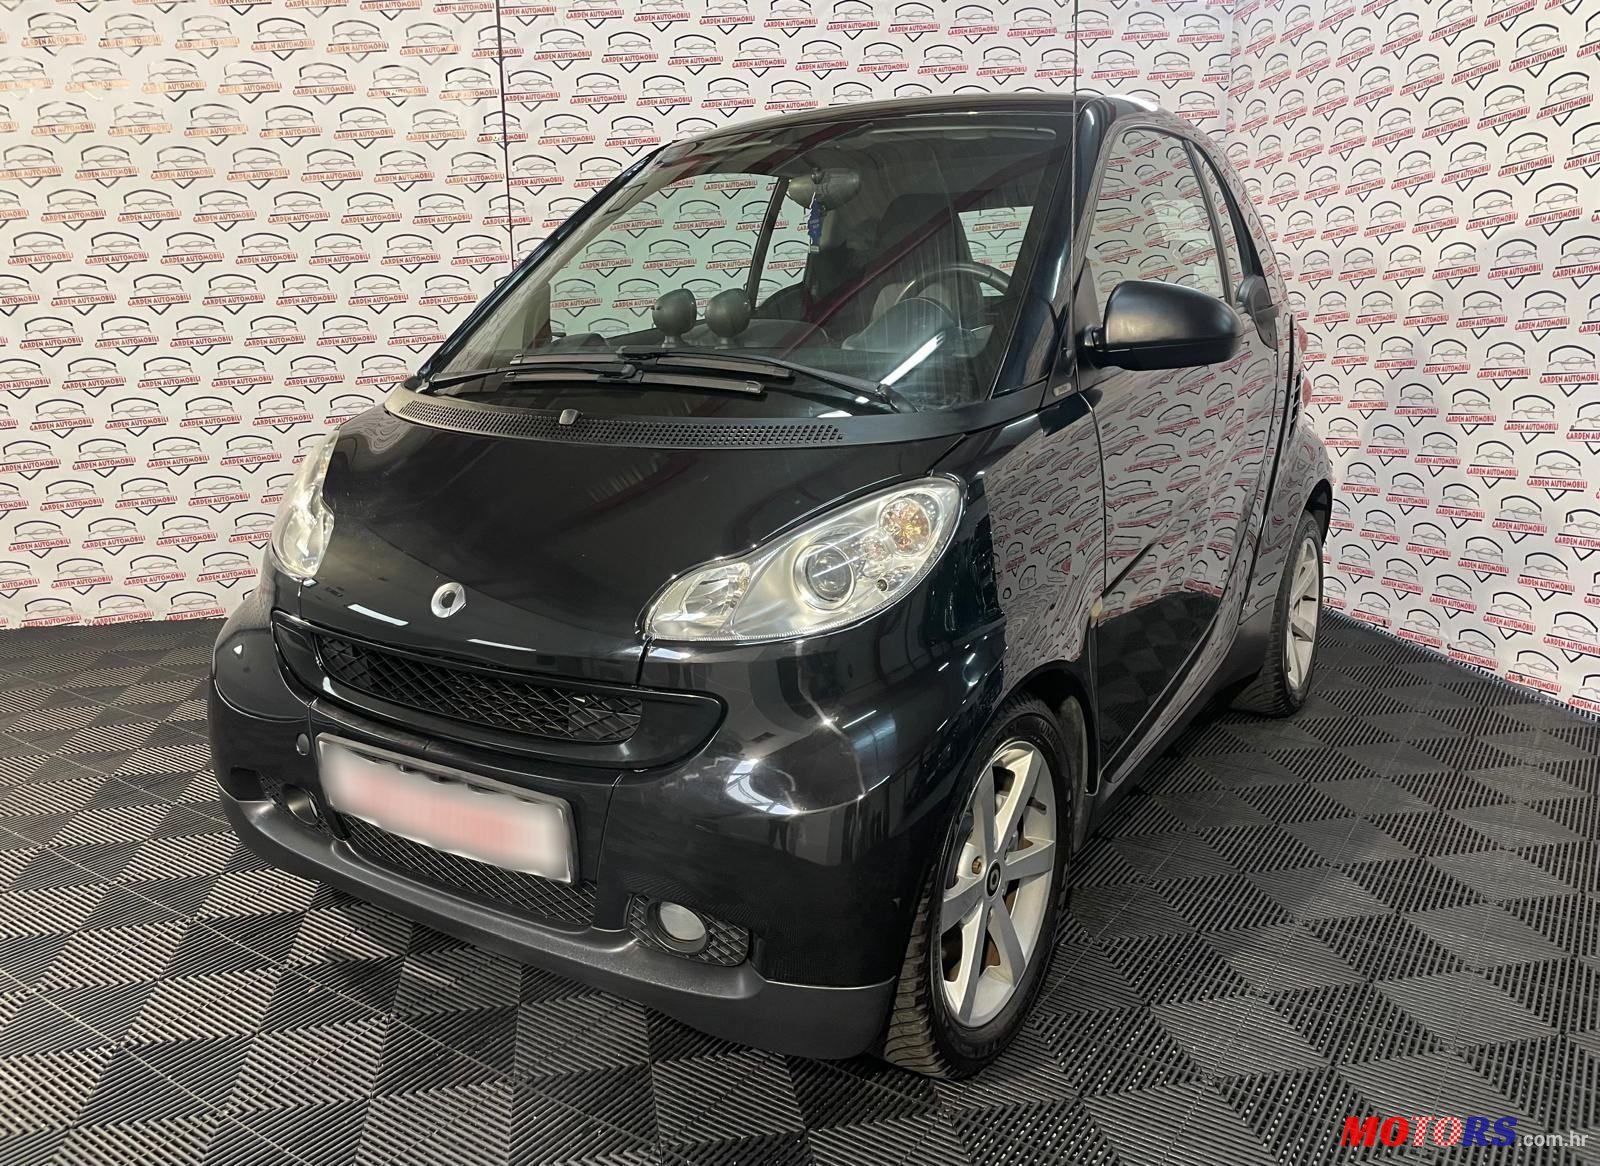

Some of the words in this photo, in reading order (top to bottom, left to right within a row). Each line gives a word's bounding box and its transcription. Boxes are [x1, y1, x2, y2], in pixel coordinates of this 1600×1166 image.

[1532, 45, 1567, 64] AUTOMOBILI
[1470, 60, 1501, 77] AUTOMOBILI
[1558, 94, 1593, 112] AUTOMOBILI
[1497, 106, 1530, 123] AUTOMOBILI
[1520, 156, 1554, 171] AUTOMOBILI
[1460, 164, 1491, 178] AUTOMOBILI
[1547, 208, 1582, 221] AUTOMOBILI
[1430, 218, 1458, 229] AUTOMOBILI
[1485, 213, 1518, 226] AUTOMOBILI
[34, 253, 74, 262] AUTOMOBILI
[186, 253, 225, 262] AUTOMOBILI
[261, 253, 299, 262] AUTOMOBILI
[333, 254, 371, 262] AUTOMOBILI
[1509, 264, 1543, 275] AUTOMOBILI
[77, 295, 117, 304] AUTOMOBILI
[153, 294, 192, 303] AUTOMOBILI
[228, 294, 266, 303] AUTOMOBILI
[301, 294, 338, 303] AUTOMOBILI
[1475, 316, 1508, 325] AUTOMOBILI
[1536, 318, 1570, 327] AUTOMOBILI
[45, 337, 84, 346] AUTOMOBILI
[121, 336, 160, 345] AUTOMOBILI
[195, 336, 234, 345] AUTOMOBILI
[269, 335, 306, 344] AUTOMOBILI
[88, 377, 127, 387] AUTOMOBILI
[163, 376, 201, 385] AUTOMOBILI
[236, 375, 274, 384] AUTOMOBILI
[309, 374, 346, 383] AUTOMOBILI
[56, 418, 95, 428] AUTOMOBILI
[131, 417, 169, 426] AUTOMOBILI
[204, 415, 242, 424] AUTOMOBILI
[277, 414, 314, 423] AUTOMOBILI
[98, 457, 137, 467] AUTOMOBILI
[245, 454, 282, 463] AUTOMOBILI
[140, 496, 178, 505] AUTOMOBILI
[213, 493, 251, 503] AUTOMOBILI
[66, 498, 105, 508] AUTOMOBILI
[1454, 510, 1484, 518] AUTOMOBILI
[1513, 524, 1547, 533] AUTOMOBILI
[108, 536, 146, 545] AUTOMOBILI
[181, 533, 219, 542] AUTOMOBILI
[34, 539, 72, 548] AUTOMOBILI
[1423, 548, 1451, 557] AUTOMOBILI
[1478, 564, 1509, 573] AUTOMOBILI
[76, 576, 114, 585] AUTOMOBILI
[149, 572, 187, 582] AUTOMOBILI
[1540, 581, 1575, 592] AUTOMOBILI
[1447, 600, 1477, 611] AUTOMOBILI
[1503, 620, 1536, 632] AUTOMOBILI
